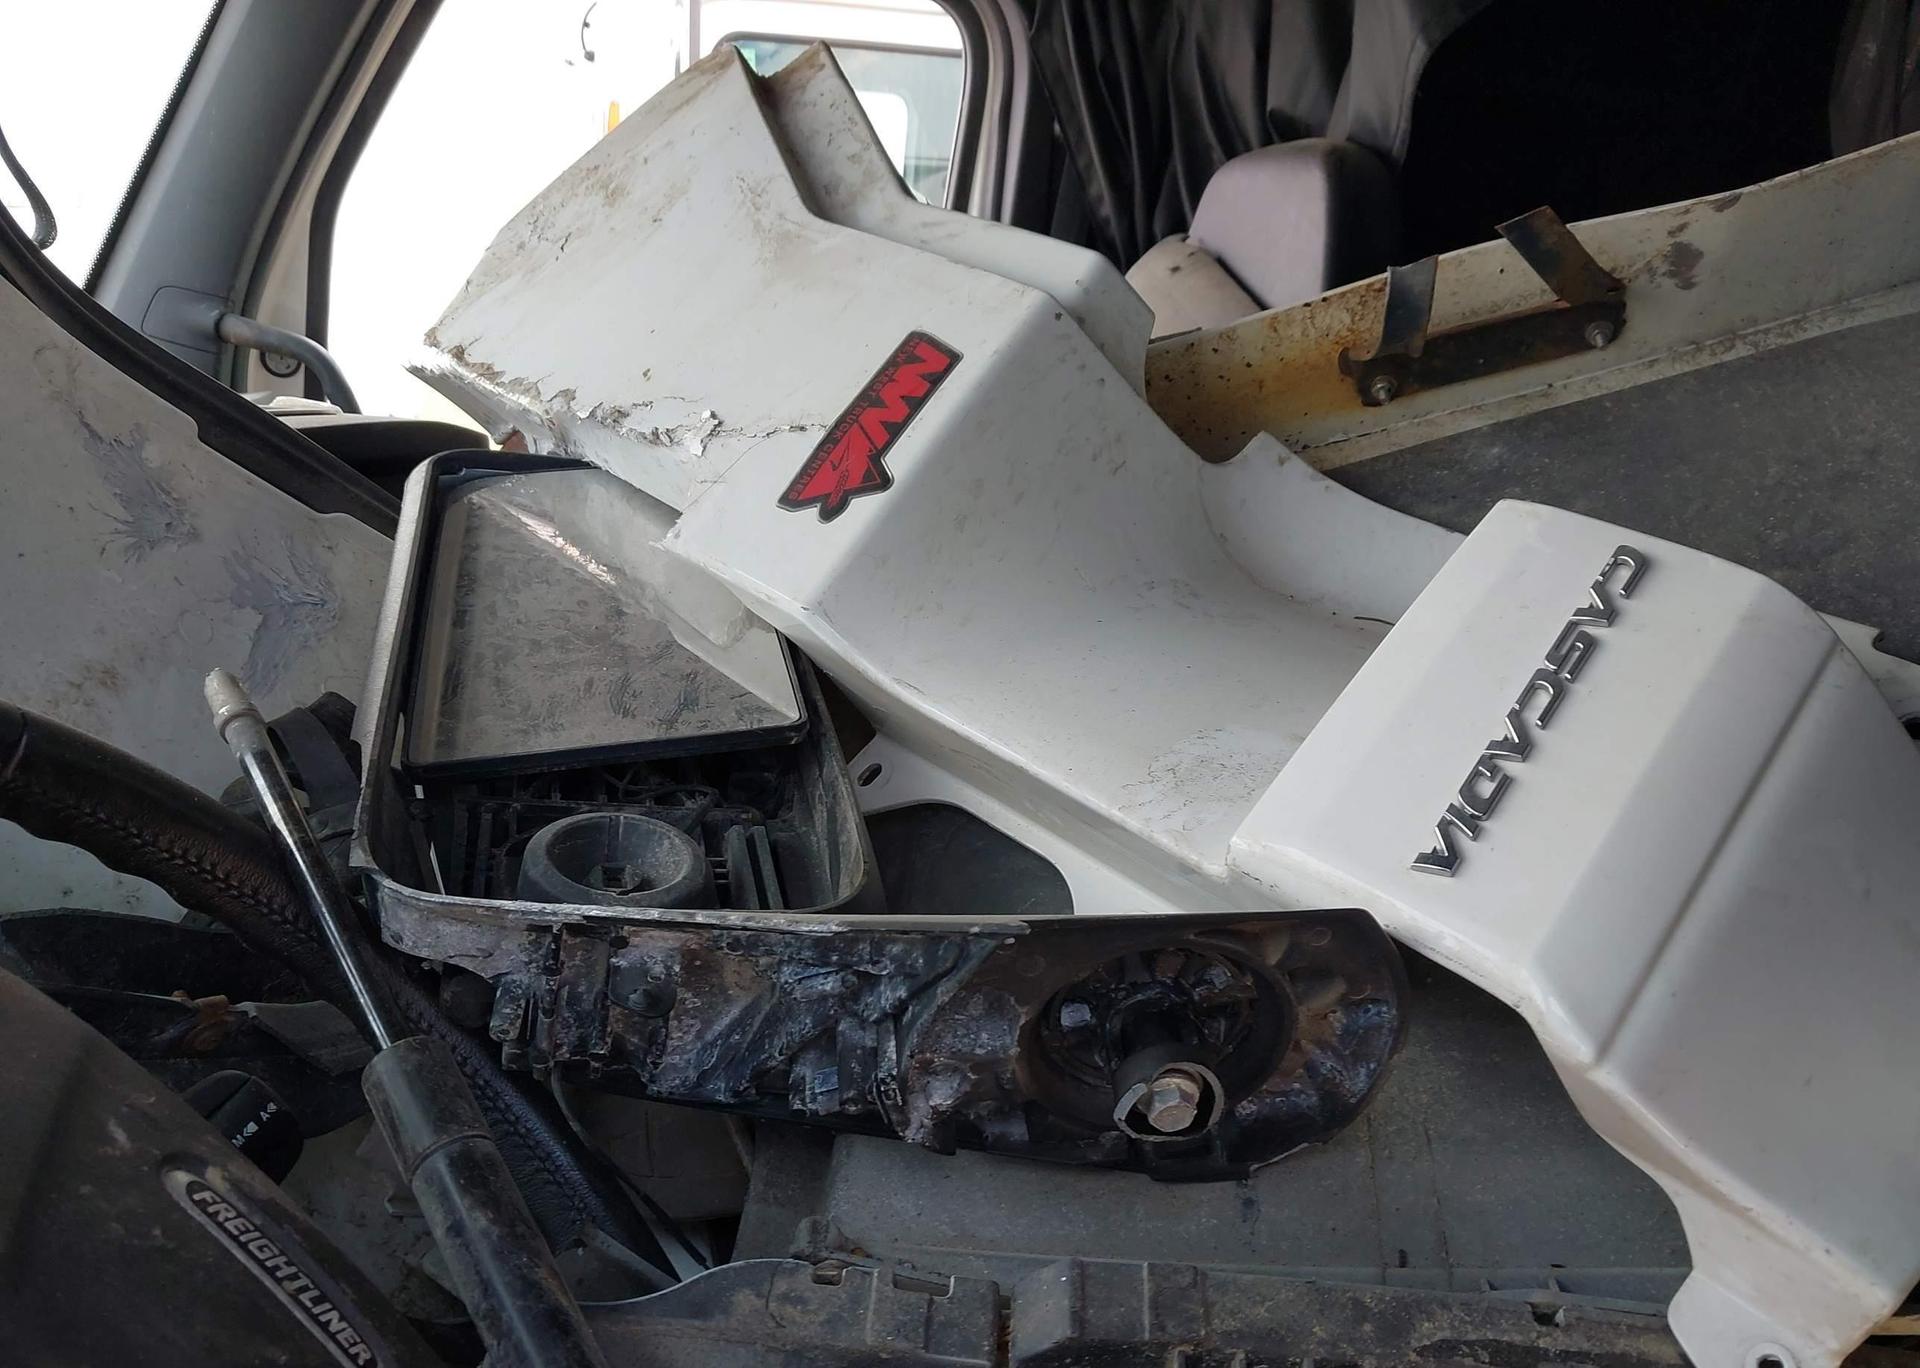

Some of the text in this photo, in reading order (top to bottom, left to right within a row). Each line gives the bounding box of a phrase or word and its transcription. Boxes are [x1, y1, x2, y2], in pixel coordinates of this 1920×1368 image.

[868, 365, 896, 398] WEST
[833, 398, 870, 442] TRUCK
[786, 443, 834, 501] CENTRES
[1410, 545, 1646, 877] CASCADIA
[192, 1190, 372, 1365] FREIGHTLINER
